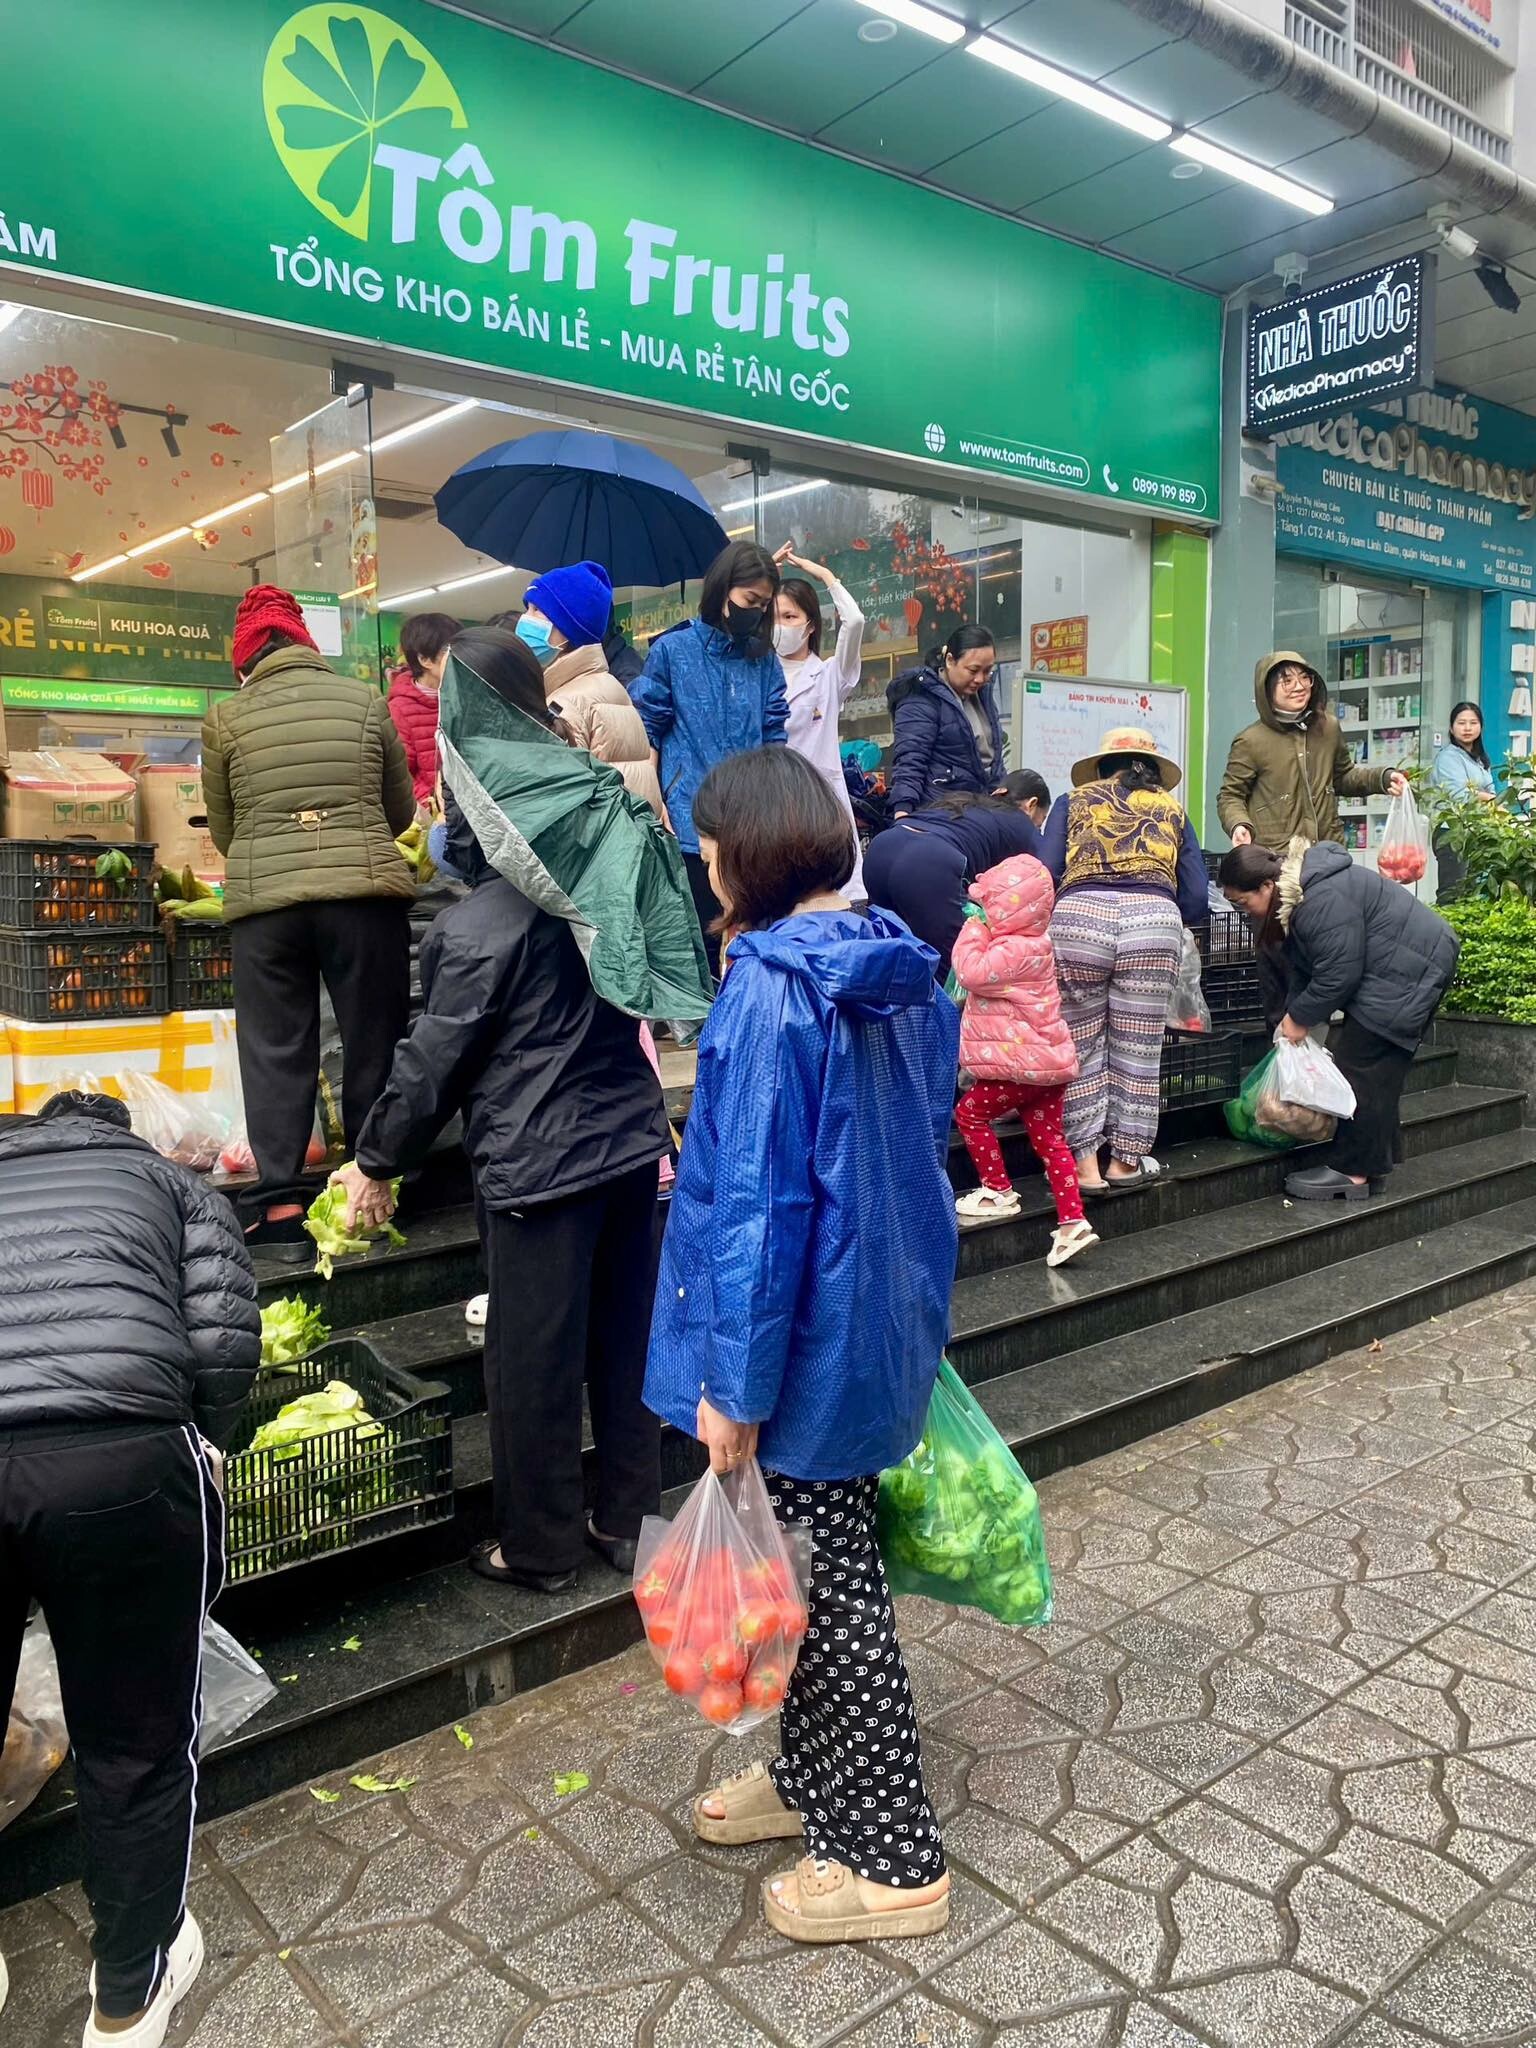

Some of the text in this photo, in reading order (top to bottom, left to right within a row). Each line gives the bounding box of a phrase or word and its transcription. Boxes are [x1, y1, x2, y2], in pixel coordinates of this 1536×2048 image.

[373, 143, 850, 357] Tôm Fruits
[270, 236, 385, 302] TỔNG
[396, 275, 472, 323] KHO
[483, 293, 550, 342] BÁN
[561, 307, 590, 351] LẺ
[621, 330, 688, 375] MUA
[695, 342, 725, 383] RẺ
[732, 355, 782, 397] TẬN
[789, 368, 850, 411] GỐC
[1259, 271, 1411, 377] NHÀ THUỐC
[1132, 476, 1197, 505] 0899 199 859
[1322, 468, 1362, 494] CHUYÊN
[1365, 478, 1385, 500] BÁN
[1389, 483, 1400, 503] LẺ
[1403, 489, 1432, 511] THUỐC
[1436, 497, 1465, 518] THÀNH
[110, 618, 211, 640] KHU HOA QUẢ
[41, 690, 64, 700] KHO
[66, 691, 89, 702] HOA
